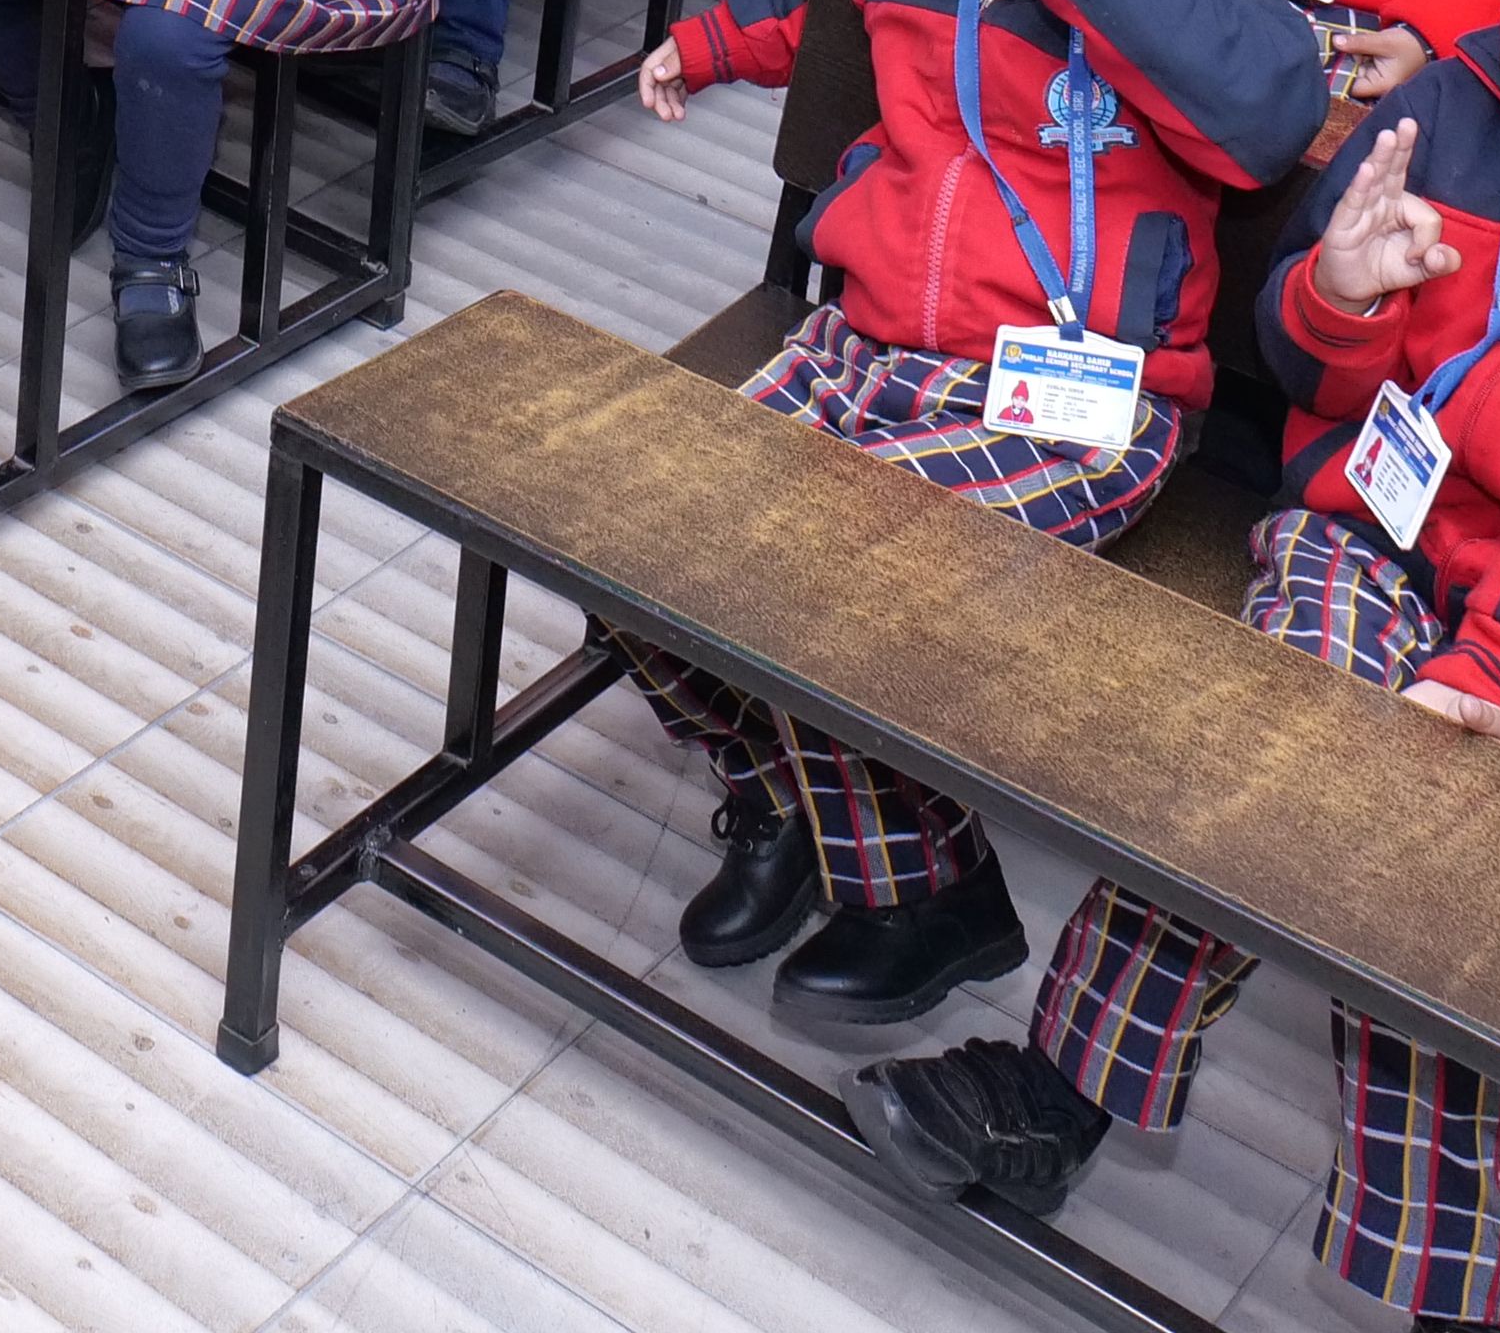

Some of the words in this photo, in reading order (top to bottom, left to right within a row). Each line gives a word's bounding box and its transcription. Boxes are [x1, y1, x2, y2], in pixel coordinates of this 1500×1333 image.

[1073, 116, 1085, 152] SCHOOL
[1073, 155, 1086, 173] SEC.
[1073, 175, 1086, 190] SR.
[1073, 192, 1087, 223] PUBLIC
[1073, 224, 1087, 250] SAHIB
[1071, 252, 1086, 293] NANKANA
